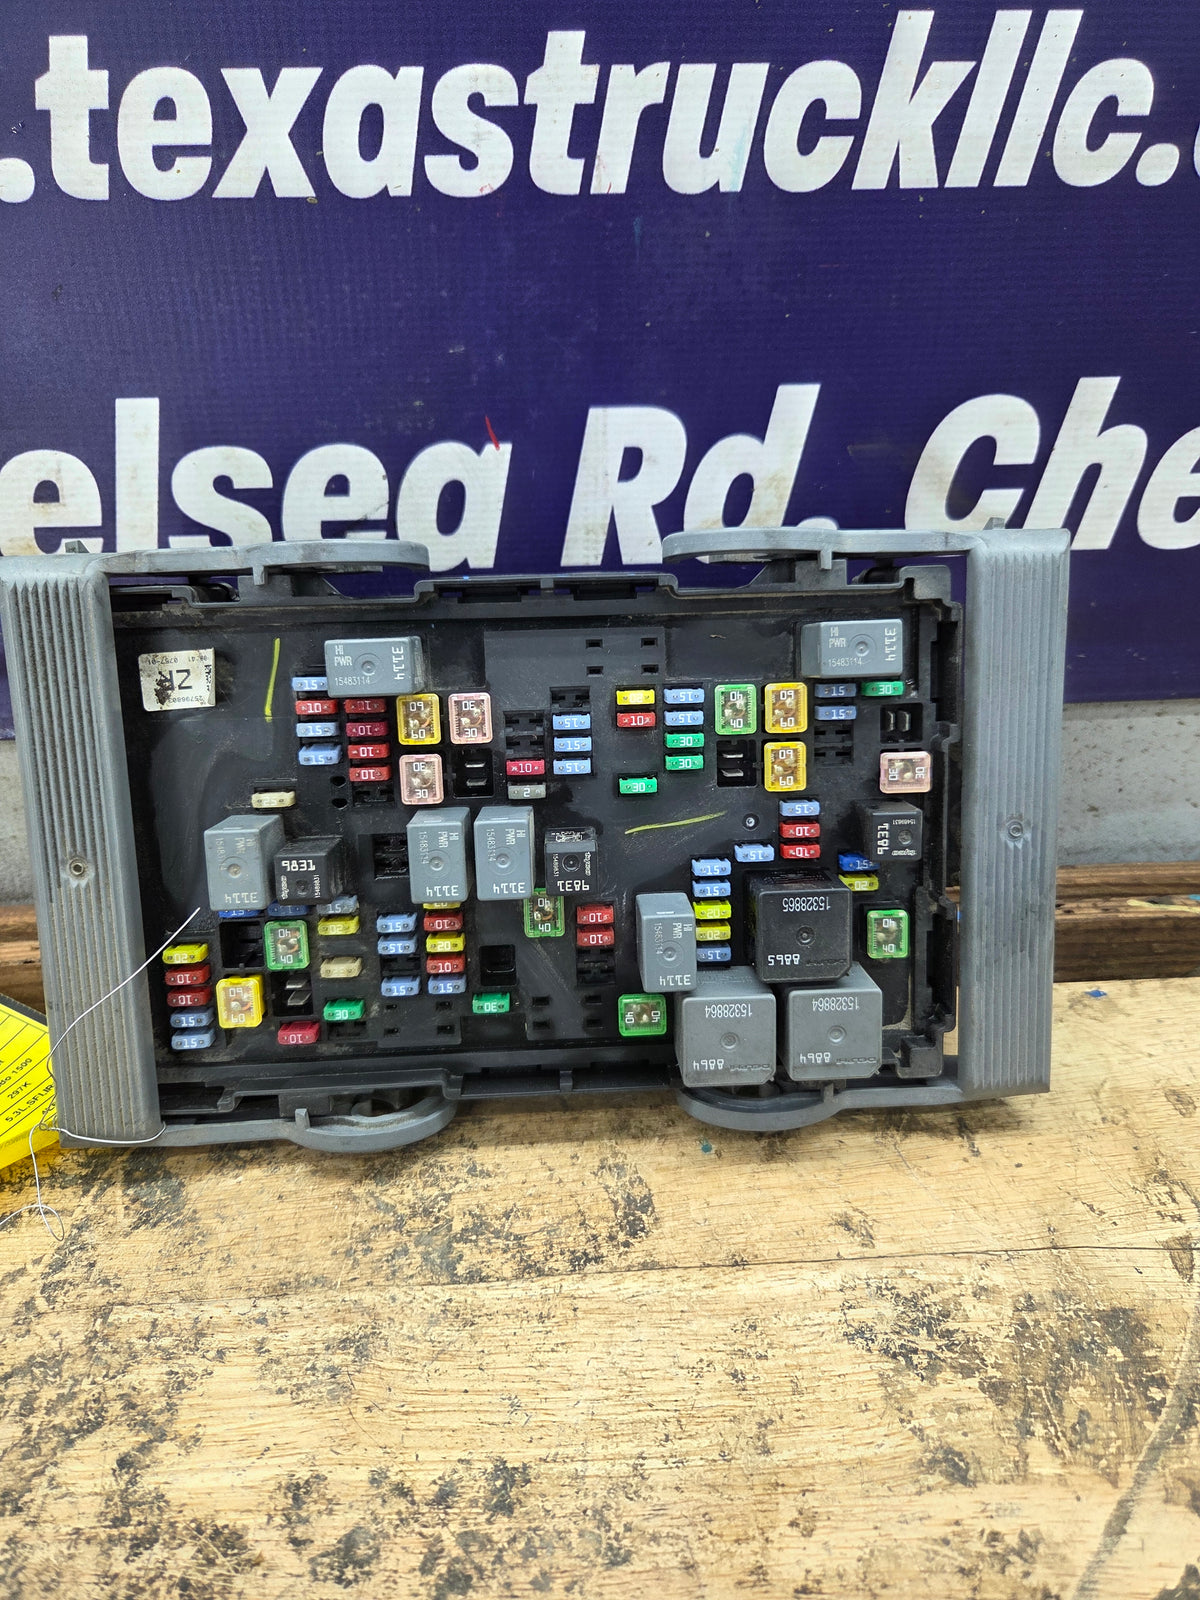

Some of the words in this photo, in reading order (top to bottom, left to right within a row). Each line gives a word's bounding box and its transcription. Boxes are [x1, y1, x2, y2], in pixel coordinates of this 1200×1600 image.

[0, 9, 1200, 203] .texastruckllc.
[561, 383, 838, 566] Rd
[905, 376, 1200, 549] Che
[830, 627, 839, 636] HI
[828, 638, 846, 648] PWR
[884, 627, 896, 662] 3114
[334, 645, 344, 654] HI
[334, 656, 352, 667] PWR
[391, 646, 405, 680] 3114
[828, 658, 862, 668] 15483114
[303, 680, 318, 690] 15
[334, 676, 370, 686] 15483114
[831, 686, 844, 696] 15
[878, 684, 892, 694] 30
[680, 691, 692, 701] 15
[730, 690, 744, 700] 40
[780, 690, 794, 700] 60
[307, 702, 322, 713] 10
[409, 702, 424, 712] 60
[462, 701, 475, 710] 30
[679, 714, 692, 724] 15
[831, 710, 845, 720] 15
[564, 718, 578, 728] 15
[630, 716, 644, 726] 10
[730, 718, 744, 728] 40
[780, 718, 794, 728] 60
[308, 726, 322, 735] 15
[358, 725, 372, 736] 10
[411, 728, 426, 739] 60
[464, 728, 477, 738] 30
[566, 740, 580, 750] 15
[680, 736, 693, 746] 30
[360, 747, 374, 757] 10
[779, 750, 793, 759] 60
[310, 755, 324, 764] 15
[678, 758, 692, 768] 30
[412, 762, 426, 772] 30
[518, 764, 532, 773] 10
[566, 762, 580, 772] 15
[362, 770, 375, 780] 10
[888, 768, 898, 780] 30
[915, 766, 925, 780] 30
[779, 776, 794, 786] 60
[523, 787, 530, 797] 2
[632, 782, 646, 792] 30
[415, 788, 428, 799] 30
[795, 804, 809, 814] 15
[449, 832, 459, 841] HI
[516, 830, 526, 838] HI
[796, 826, 810, 837] 10
[438, 831, 448, 848] PWR
[505, 828, 516, 846] PWR
[877, 822, 889, 855] 9831
[418, 830, 430, 865] 15483114
[486, 828, 496, 863] 15483114
[750, 851, 764, 860] 15
[796, 847, 810, 858] 10
[281, 860, 316, 872] 9831
[856, 859, 870, 870] 15
[706, 864, 720, 876] 15
[493, 882, 526, 894] 3114
[558, 880, 590, 892] 9831
[854, 880, 868, 890] 20
[426, 885, 460, 897] 3114
[706, 886, 720, 896] 15
[224, 892, 258, 904] 3114
[538, 898, 550, 907] 40
[328, 903, 342, 914] 15
[782, 896, 831, 912] 15328865
[588, 912, 603, 922] 10
[706, 908, 720, 918] 20
[388, 922, 402, 932] 15
[436, 920, 450, 930] 10
[538, 922, 552, 932] 40
[882, 918, 895, 928] 40
[278, 928, 292, 938] 40
[330, 924, 344, 934] 20
[672, 922, 682, 939] PWR
[589, 934, 604, 944] 10
[706, 930, 721, 940] 20
[388, 944, 403, 953] 15
[436, 941, 452, 950] 20
[882, 944, 895, 954] 40
[174, 954, 188, 963] 20
[280, 954, 294, 964] 40
[708, 950, 721, 960] 15
[768, 954, 800, 966] 8865
[438, 962, 452, 972] 10
[176, 974, 190, 984] 10
[659, 974, 692, 986] 3114
[228, 988, 243, 998] 60
[392, 986, 406, 996] 15
[439, 983, 452, 993] 15
[178, 995, 192, 1005] 10
[812, 996, 860, 1012] 15328864
[484, 1002, 498, 1012] 30
[704, 1002, 752, 1018] 15328864
[232, 1013, 246, 1023] 60
[334, 1010, 348, 1019] 30
[625, 1011, 634, 1024] 40
[651, 1010, 660, 1023] 40
[181, 1016, 195, 1026] 15
[183, 1038, 198, 1048] 15
[289, 1034, 303, 1044] 10
[800, 1052, 831, 1064] 8864
[692, 1058, 724, 1070] 8864
